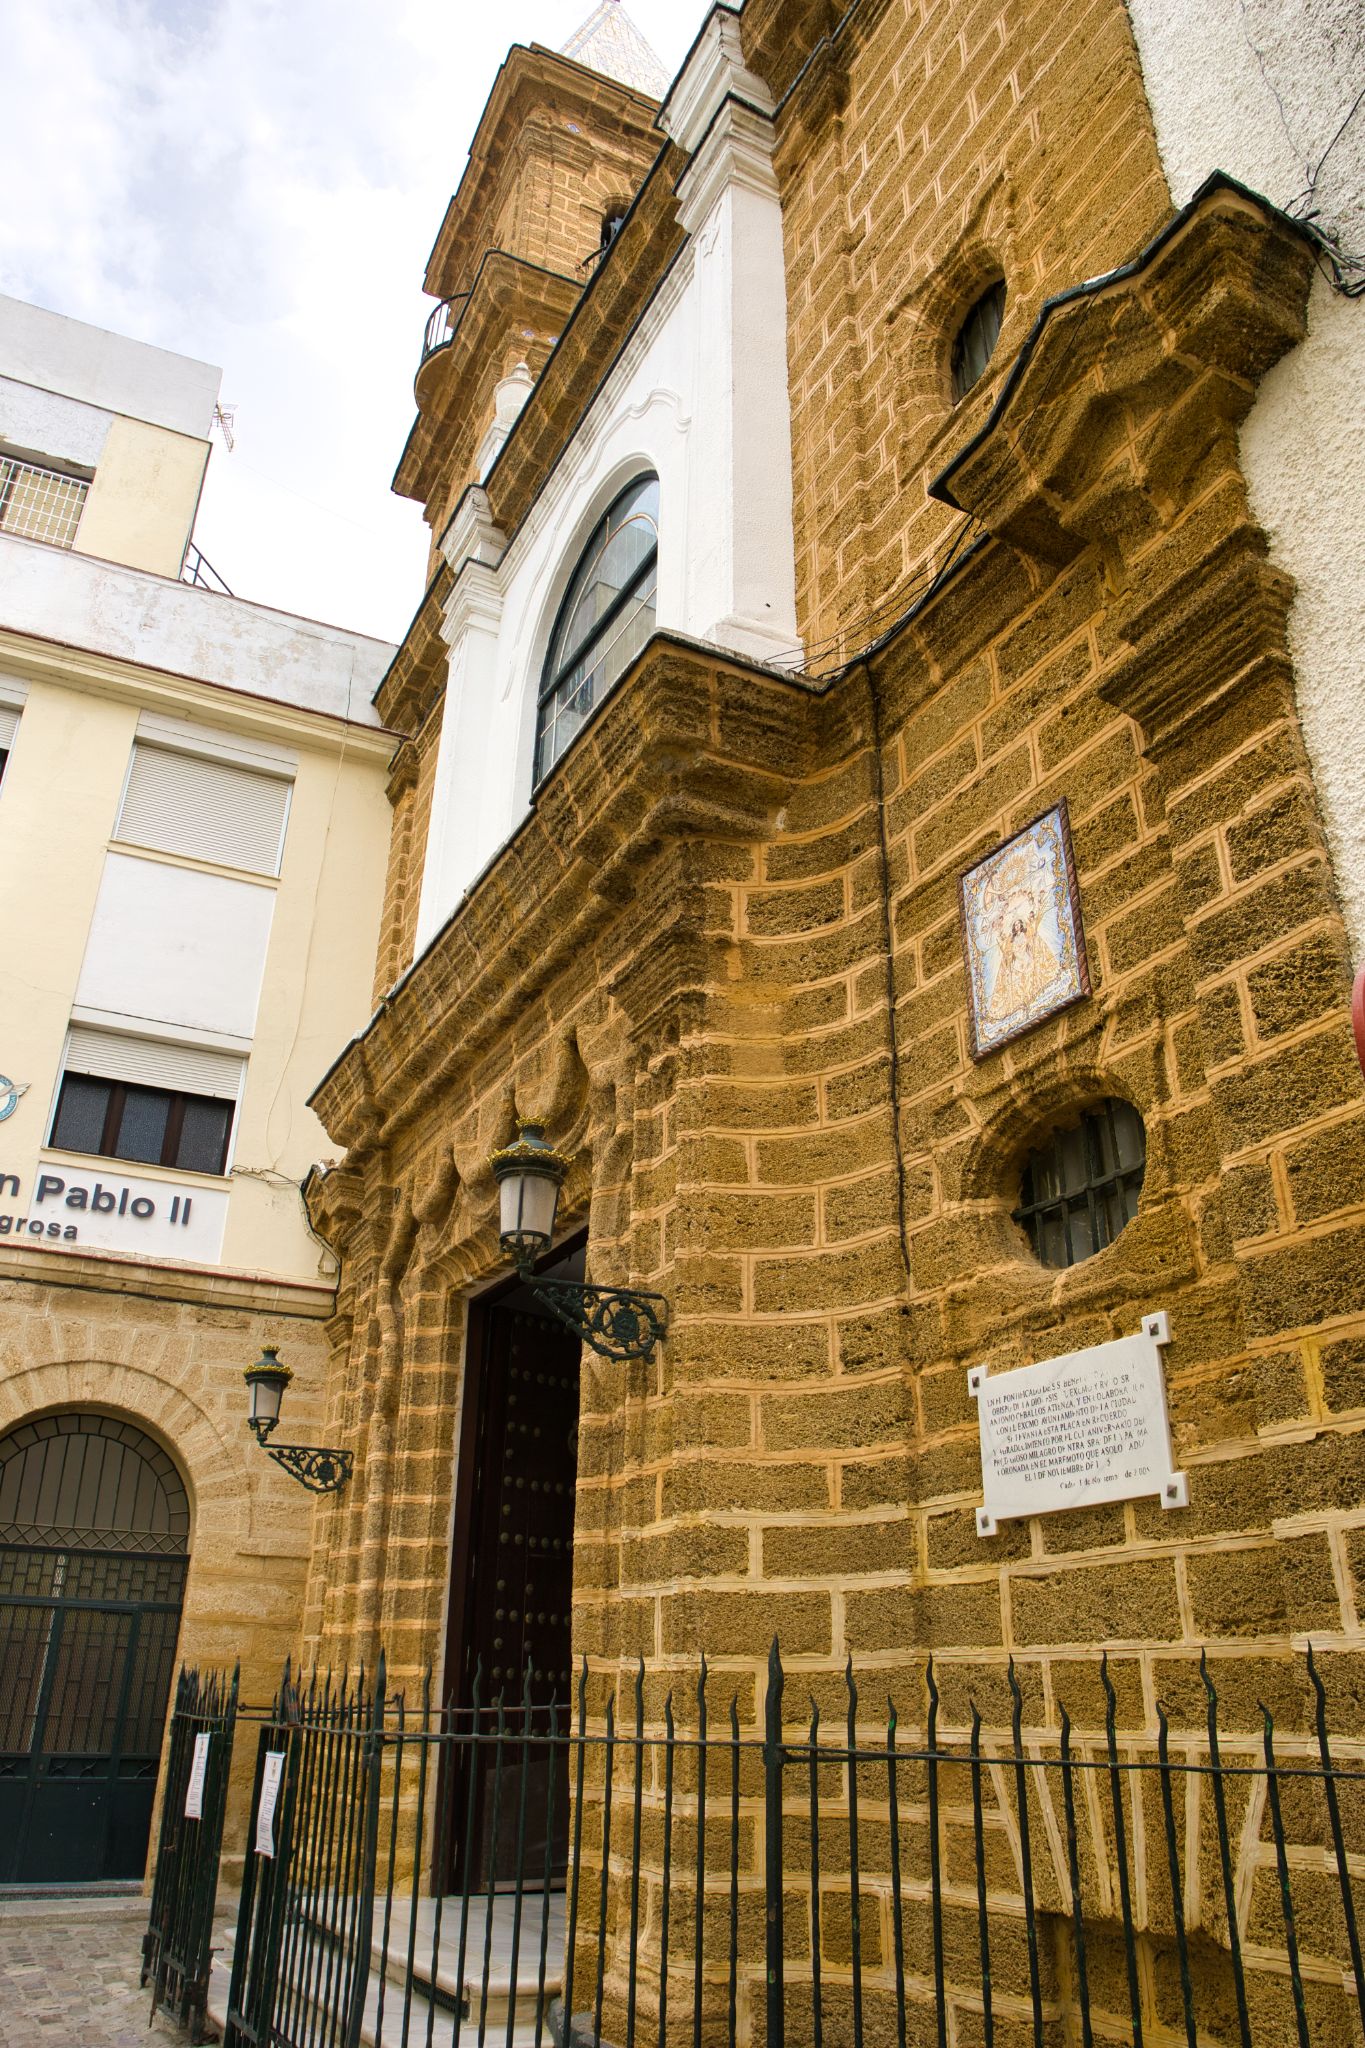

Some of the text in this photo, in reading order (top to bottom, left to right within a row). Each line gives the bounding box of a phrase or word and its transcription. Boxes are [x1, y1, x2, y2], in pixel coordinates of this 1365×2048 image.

[36, 1175, 155, 1218] Pablo
[1059, 1419, 1080, 1431] PLACA
[1028, 1446, 1056, 1460] MILAGRO
[1124, 1426, 1148, 1440] PAMA
[1050, 1433, 1062, 1444] POR
[1085, 1448, 1099, 1459] QUE
